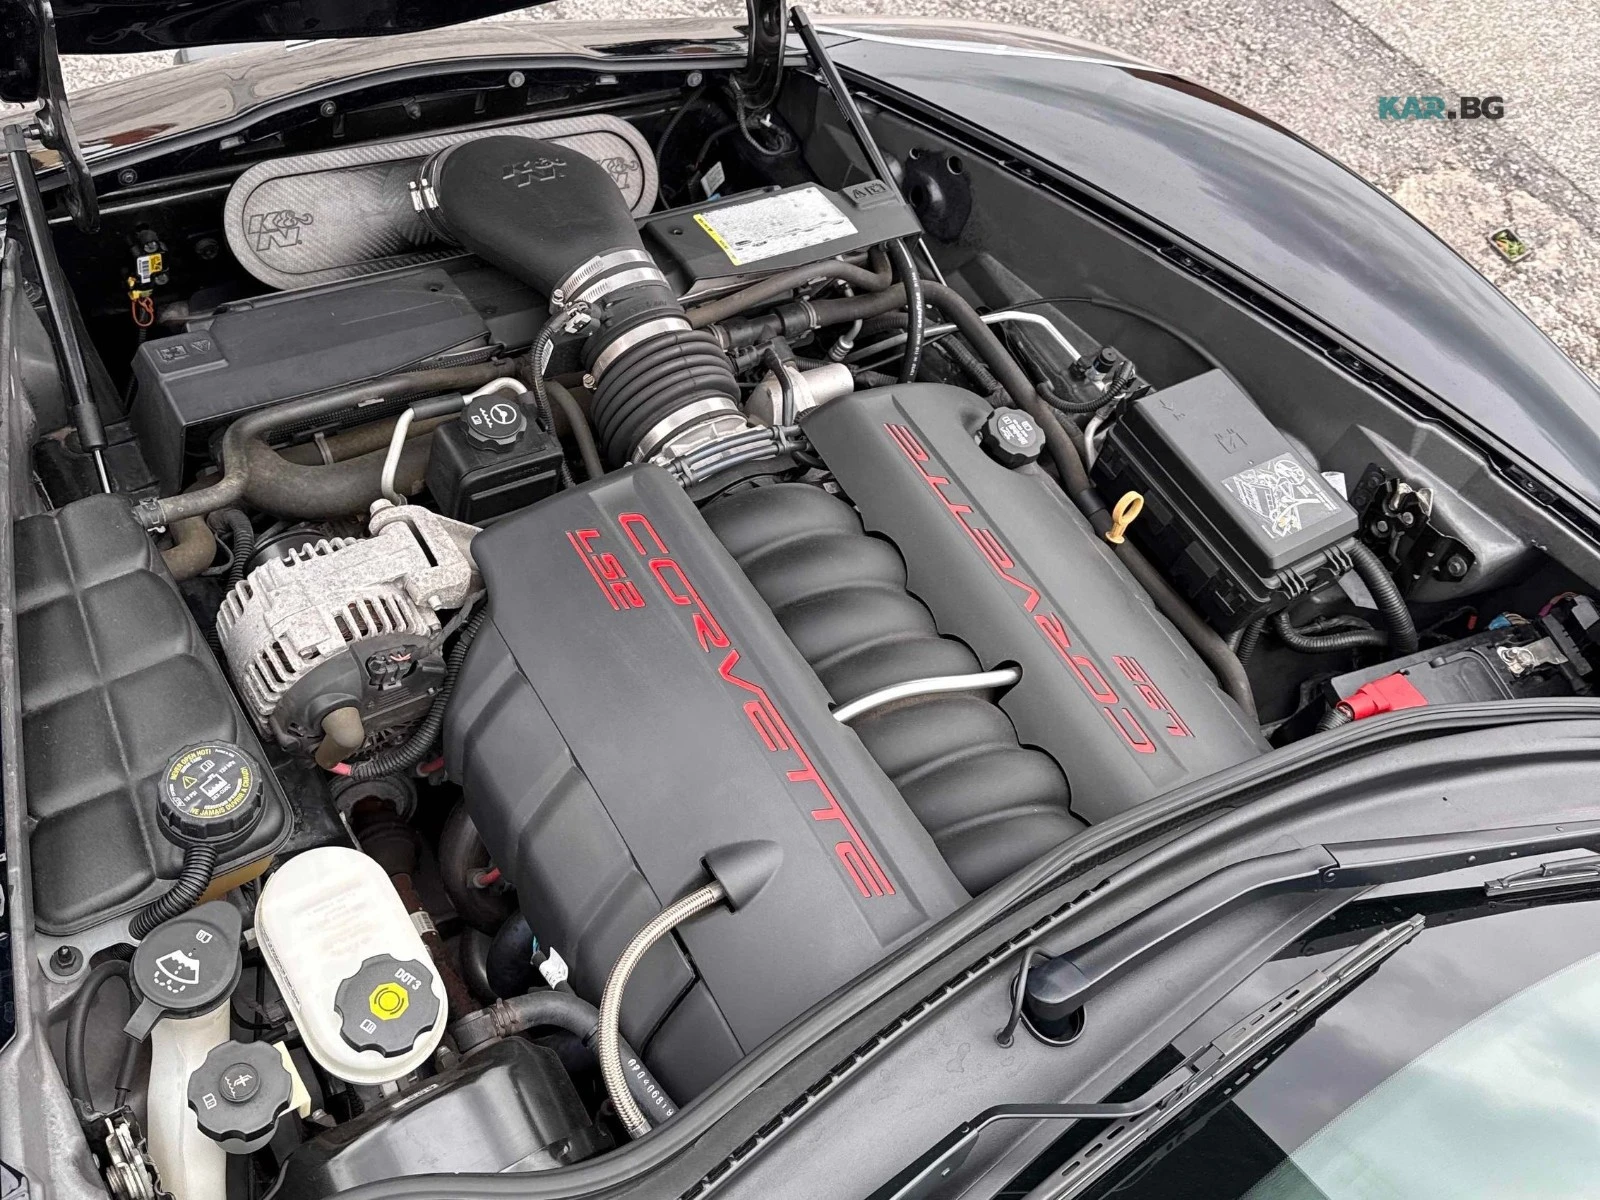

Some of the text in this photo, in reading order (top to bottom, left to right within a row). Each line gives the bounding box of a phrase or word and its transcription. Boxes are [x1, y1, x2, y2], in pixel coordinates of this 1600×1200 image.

[565, 529, 647, 611] LS2
[883, 422, 1157, 755] CORVETTE
[618, 512, 896, 899] CORVETTE
[1112, 655, 1196, 738] LS2
[170, 764, 183, 781] NEVER
[181, 751, 198, 766] OPEN
[196, 748, 212, 757] HOT!
[199, 805, 226, 816] JAMAIS
